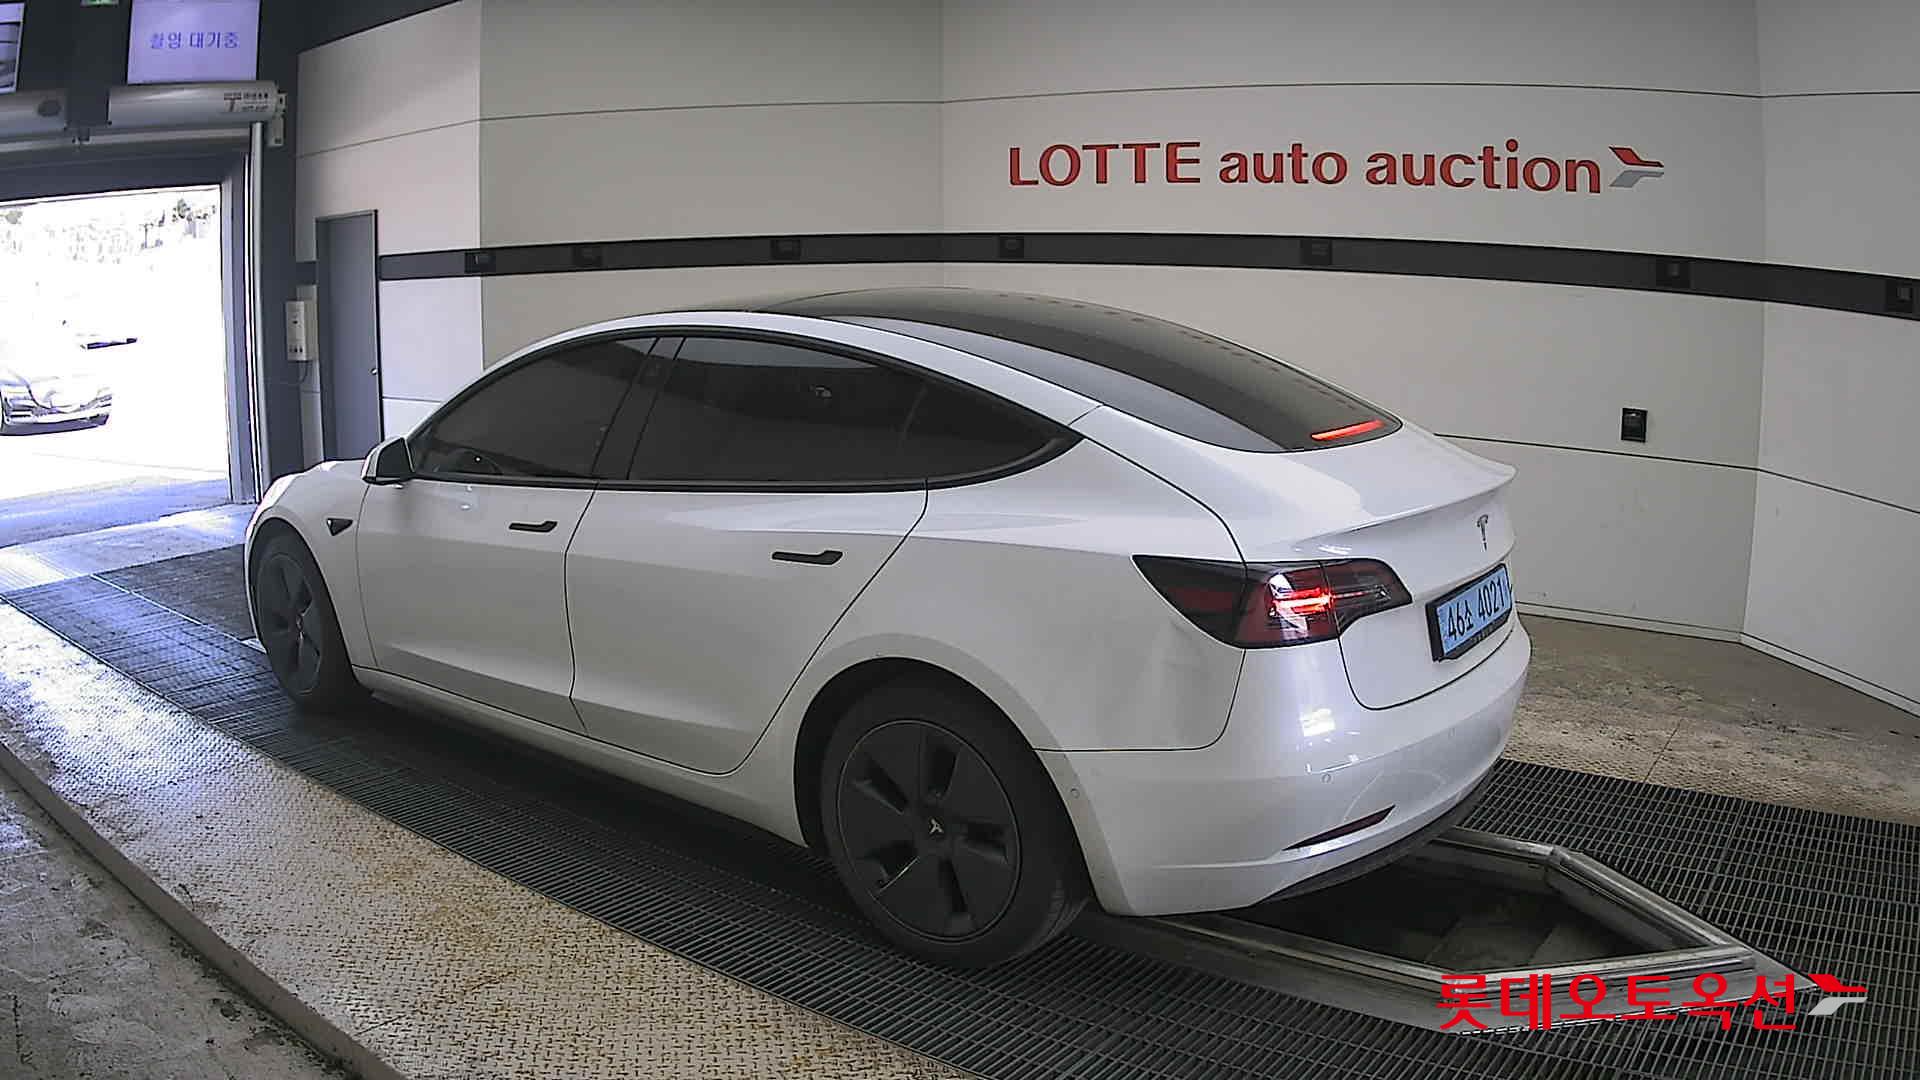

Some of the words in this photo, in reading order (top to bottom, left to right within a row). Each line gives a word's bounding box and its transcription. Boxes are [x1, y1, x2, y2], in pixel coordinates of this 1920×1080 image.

[189, 31, 240, 49] 대기중
[1009, 142, 1201, 186] LOTTE
[1218, 143, 1348, 184] auto
[1365, 138, 1601, 193] auction
[1447, 599, 1474, 641] 46소
[1477, 576, 1505, 621] 4021
